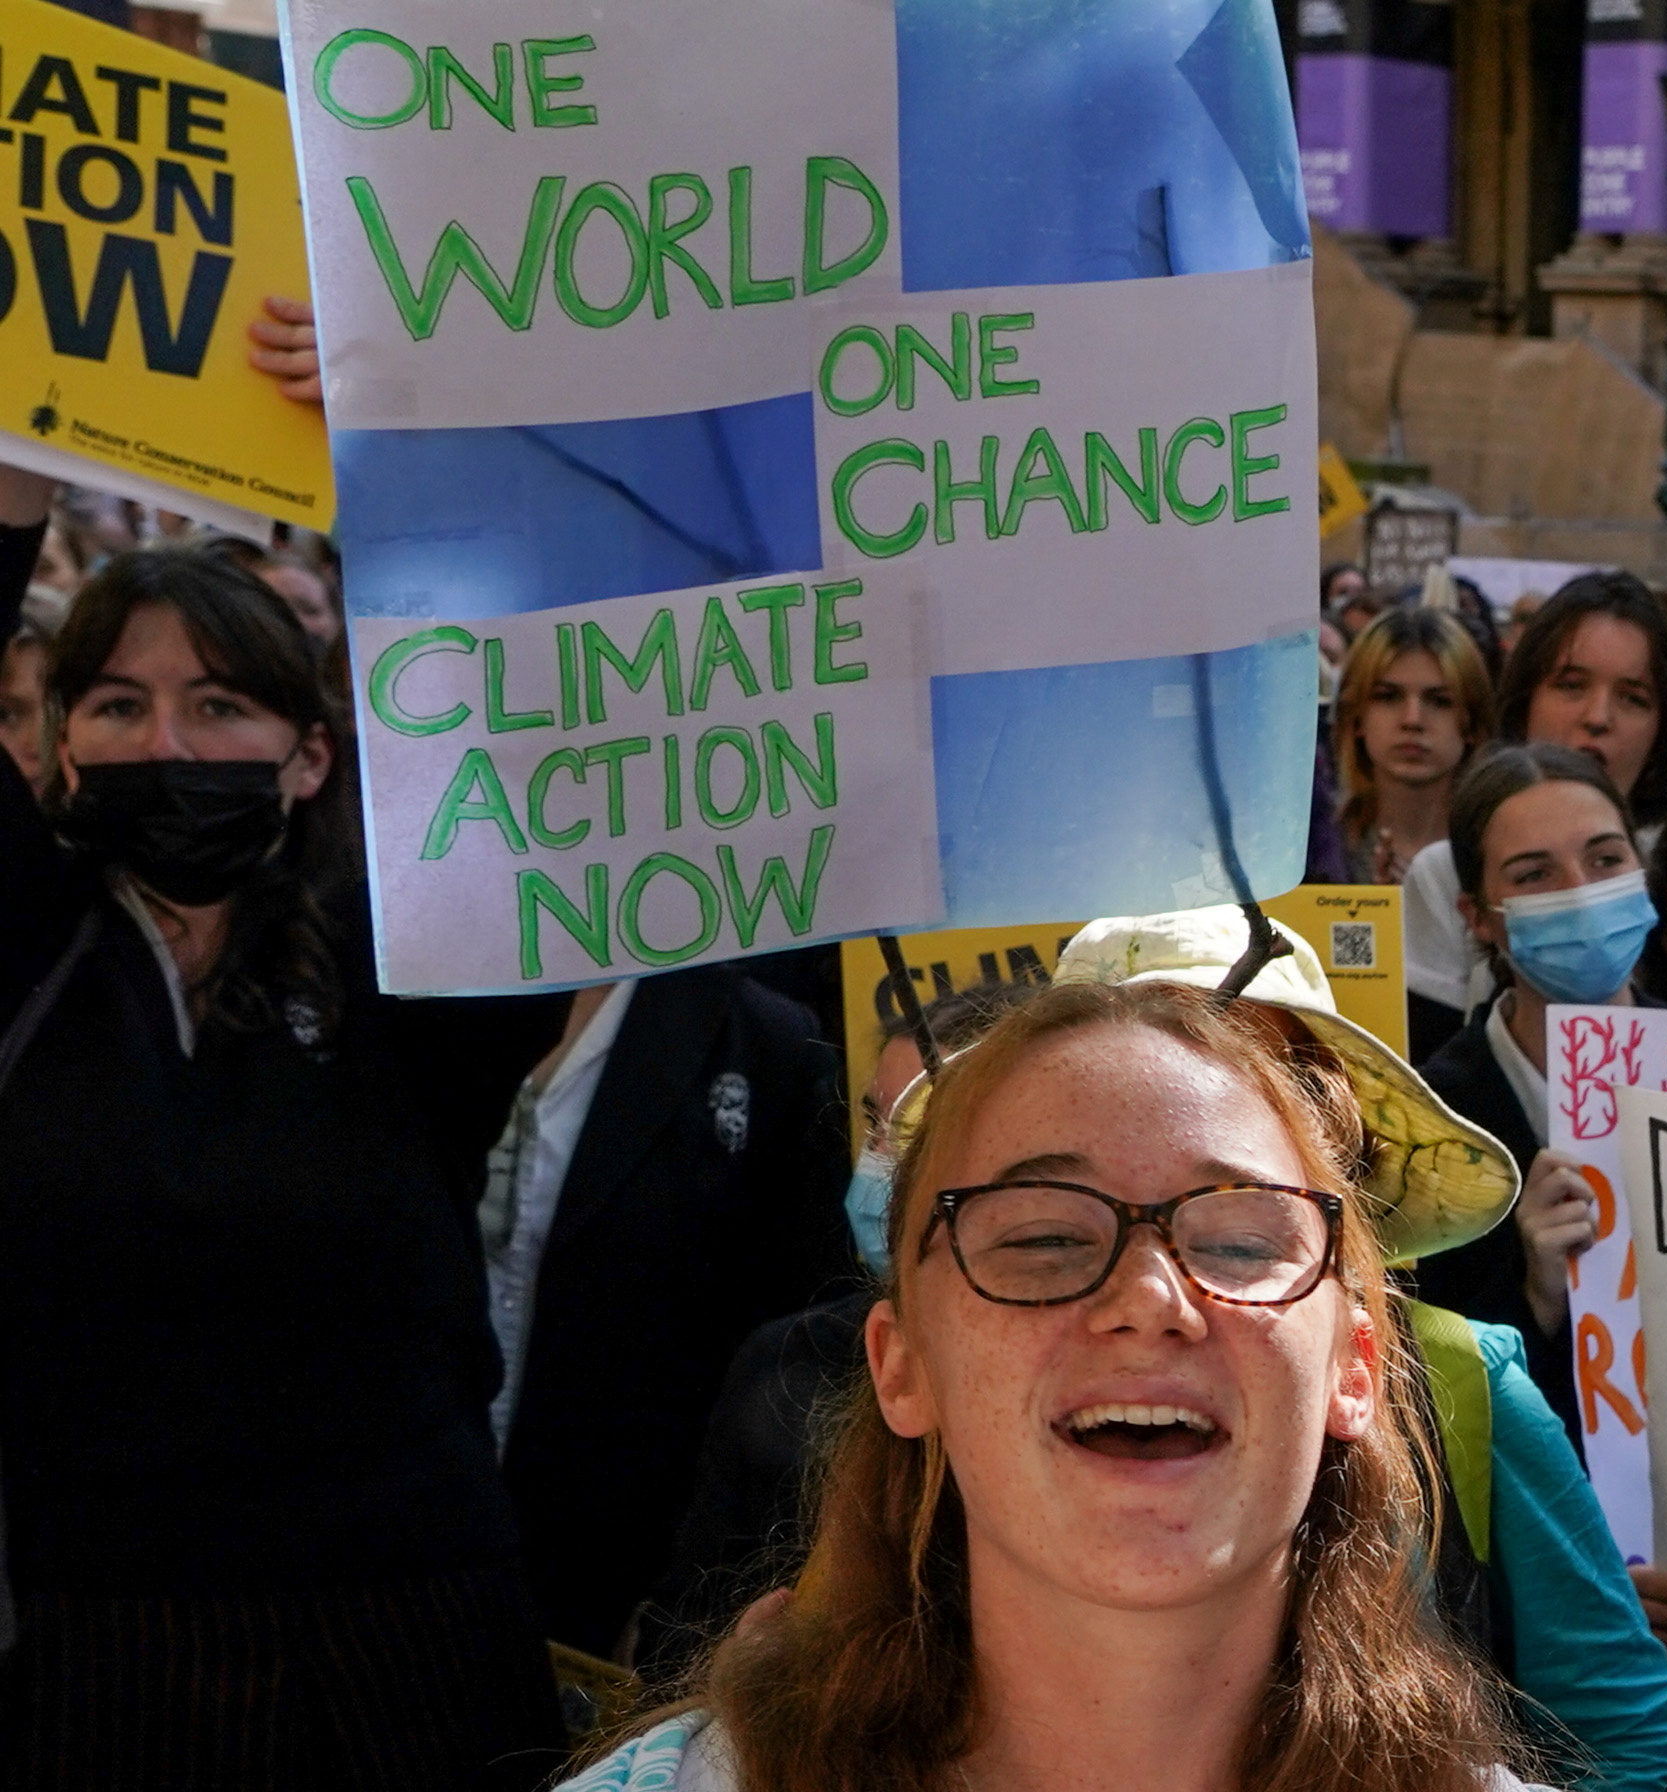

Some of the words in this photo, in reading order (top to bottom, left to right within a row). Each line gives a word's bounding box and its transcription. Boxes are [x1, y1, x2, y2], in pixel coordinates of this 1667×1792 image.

[0, 45, 230, 163] ATE
[314, 29, 596, 131] ONE
[0, 127, 234, 249] ION
[346, 156, 890, 340] WORLD
[820, 312, 1041, 416] ONE
[831, 404, 1291, 558] CHANCE
[369, 578, 869, 735] CLIMATE
[421, 712, 839, 860] ACTION
[517, 824, 836, 980] NOW
